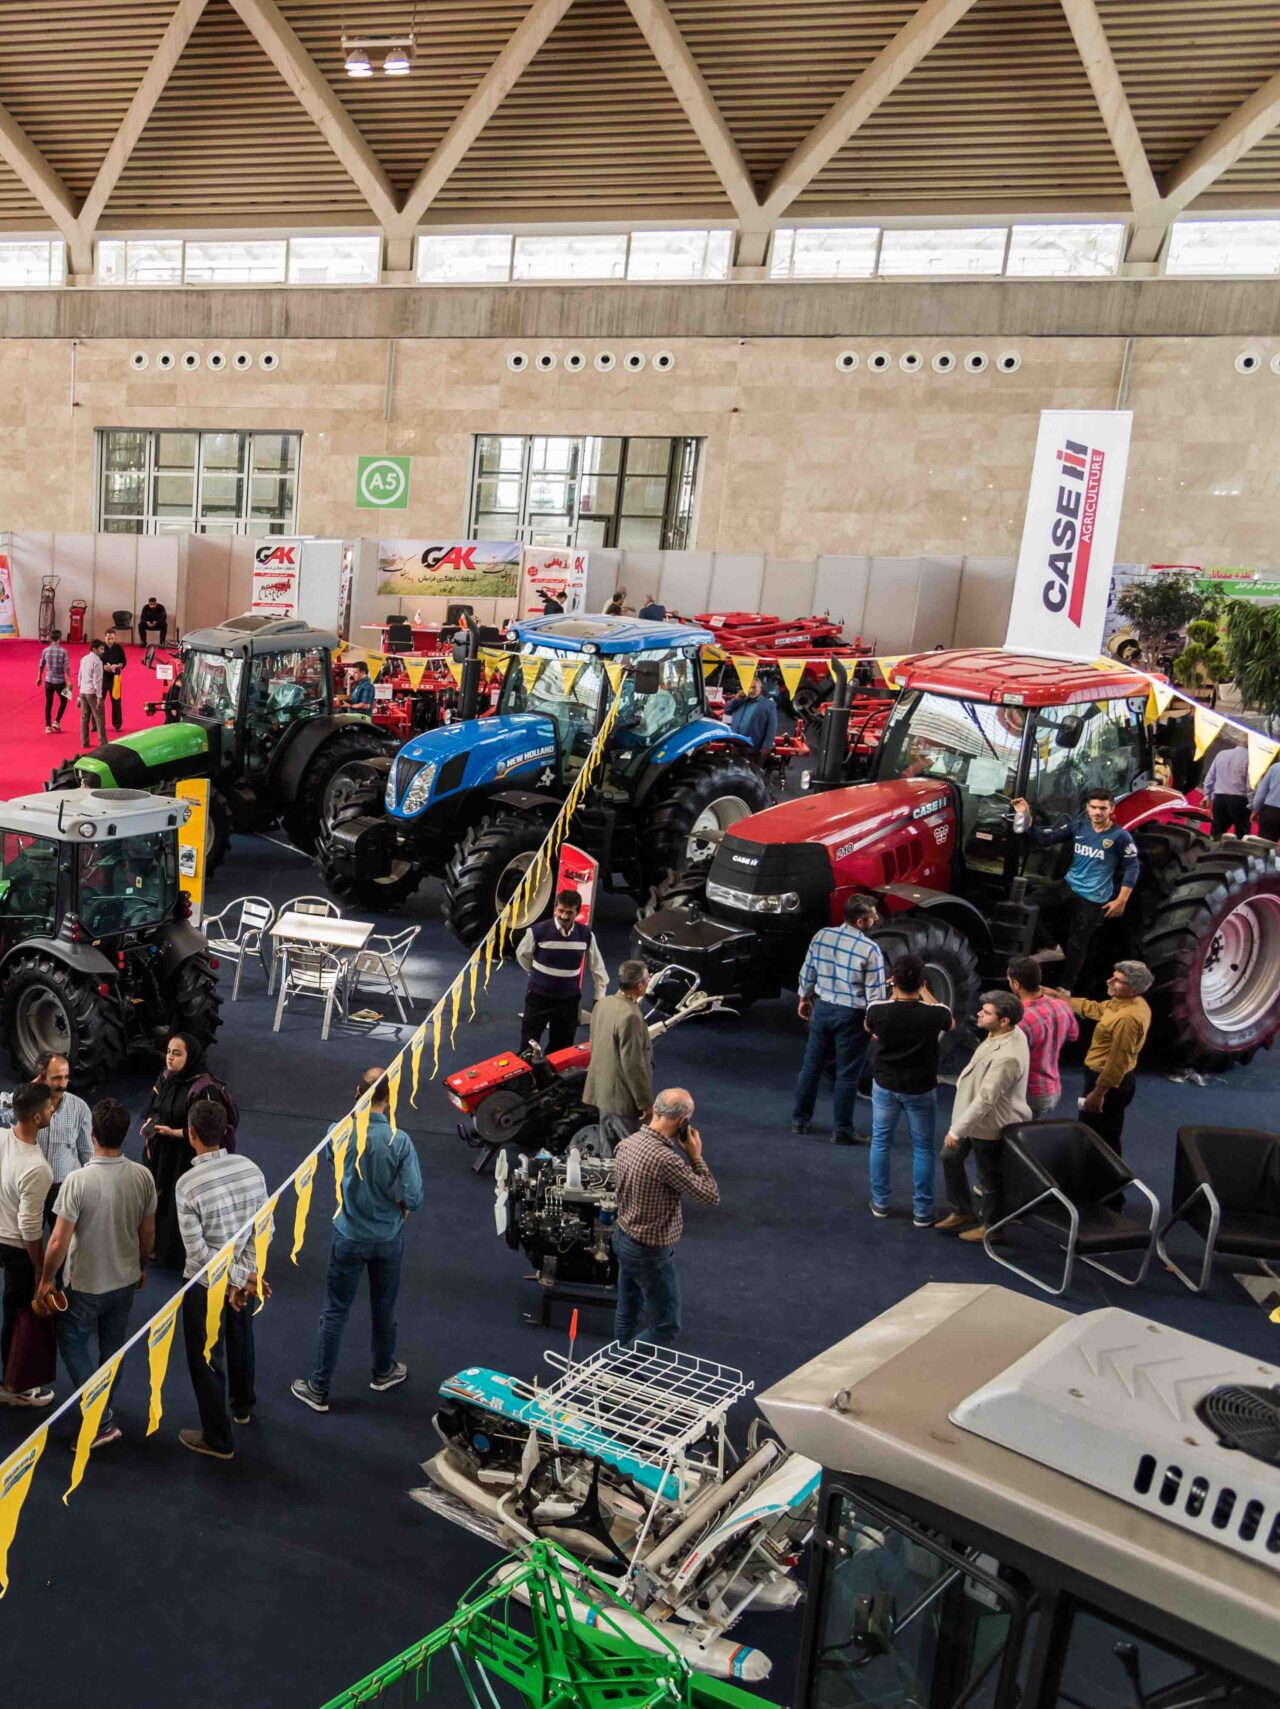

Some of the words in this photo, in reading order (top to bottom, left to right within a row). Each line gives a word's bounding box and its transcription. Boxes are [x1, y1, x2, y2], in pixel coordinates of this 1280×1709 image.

[368, 474, 398, 491] A5
[1081, 452, 1104, 543] AGRICULTURE
[255, 546, 296, 565] GAK
[421, 546, 477, 571] GAK
[1042, 485, 1082, 613] CASE
[506, 754, 524, 768] NEW
[524, 745, 555, 760] HOLLAND
[913, 800, 939, 820] CASE
[732, 854, 751, 865] CASE
[1074, 842, 1105, 860] BBVA
